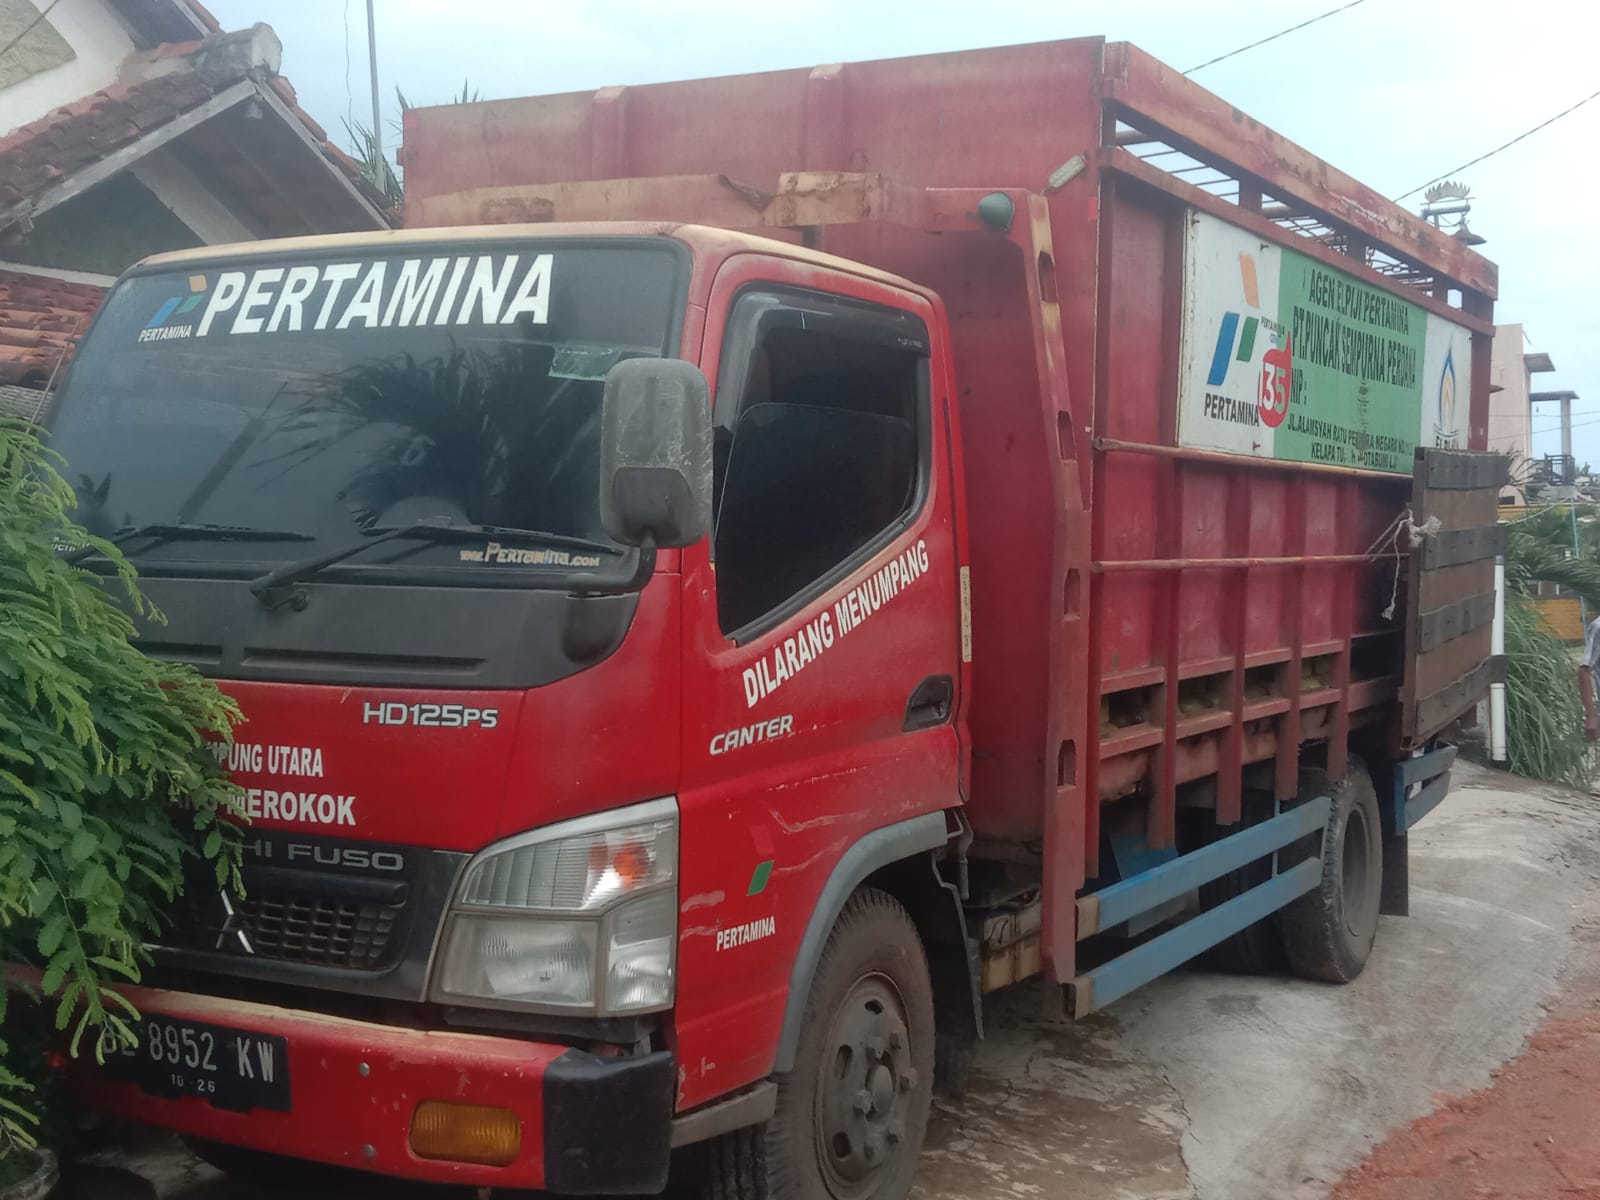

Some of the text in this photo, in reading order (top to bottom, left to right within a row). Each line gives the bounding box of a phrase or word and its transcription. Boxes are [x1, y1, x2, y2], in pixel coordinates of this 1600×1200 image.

[196, 254, 554, 337] PERTAMINA
[1309, 269, 1409, 336] AGEN ELPIJI PERTAMINA
[138, 325, 192, 343] PERTAMINA
[1341, 325, 1385, 382] SEMPURNA
[1258, 362, 1286, 414] 135
[1204, 393, 1260, 427] PERTAMINA
[1311, 441, 1336, 462] KELAPA
[742, 614, 834, 708] DILARANG
[836, 539, 929, 637] MENUMPANG
[363, 702, 499, 728] HD125PS
[709, 714, 793, 755] CANTER
[268, 745, 324, 777] UTARA
[227, 787, 356, 825] MEROKOK
[288, 843, 404, 871] FUSO
[716, 916, 775, 951] PERTAMINA
[148, 1021, 217, 1071] 8952
[237, 1036, 273, 1083] KW
[171, 1073, 216, 1092] 10 26
